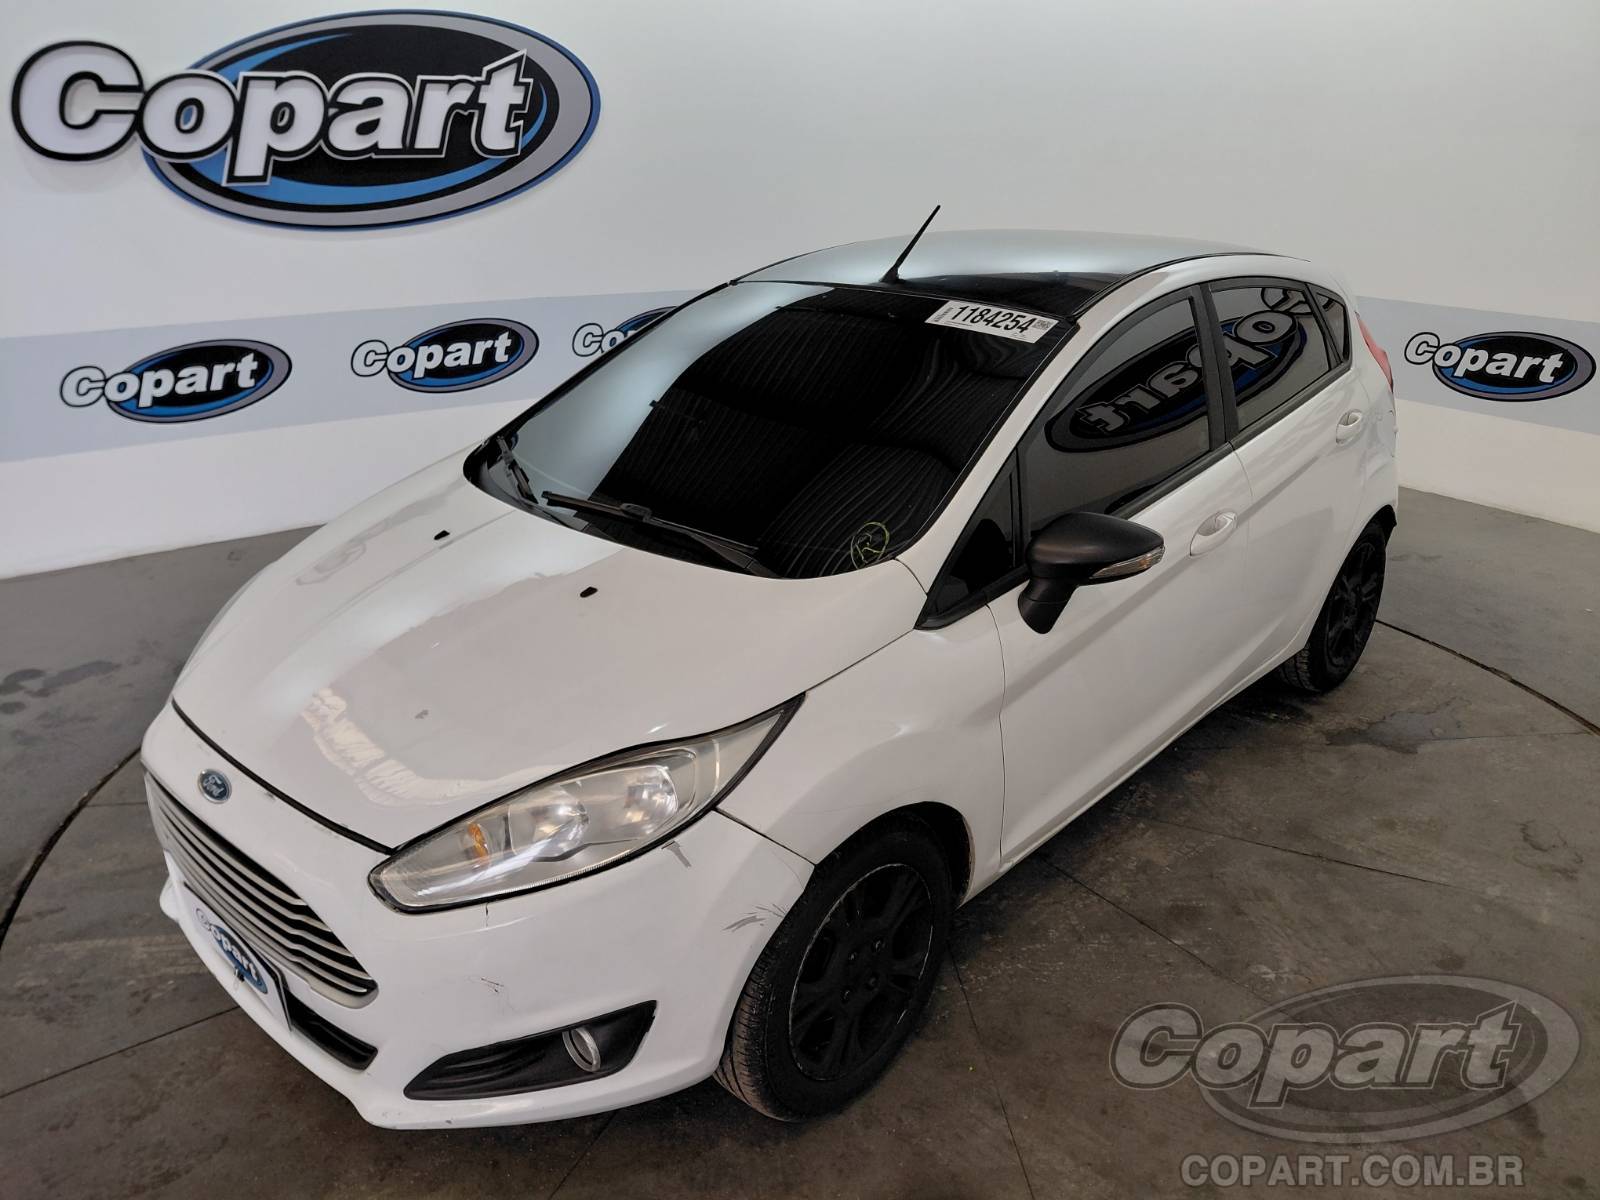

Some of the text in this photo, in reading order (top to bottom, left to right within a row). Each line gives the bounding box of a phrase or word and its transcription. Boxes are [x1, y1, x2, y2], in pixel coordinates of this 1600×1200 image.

[12, 41, 533, 186] Copart
[572, 323, 637, 357] Co
[951, 305, 1038, 333] 1184254
[60, 352, 258, 407] Copart
[351, 331, 512, 380] Copart
[1404, 332, 1563, 384] Copart
[195, 907, 259, 982] Copart
